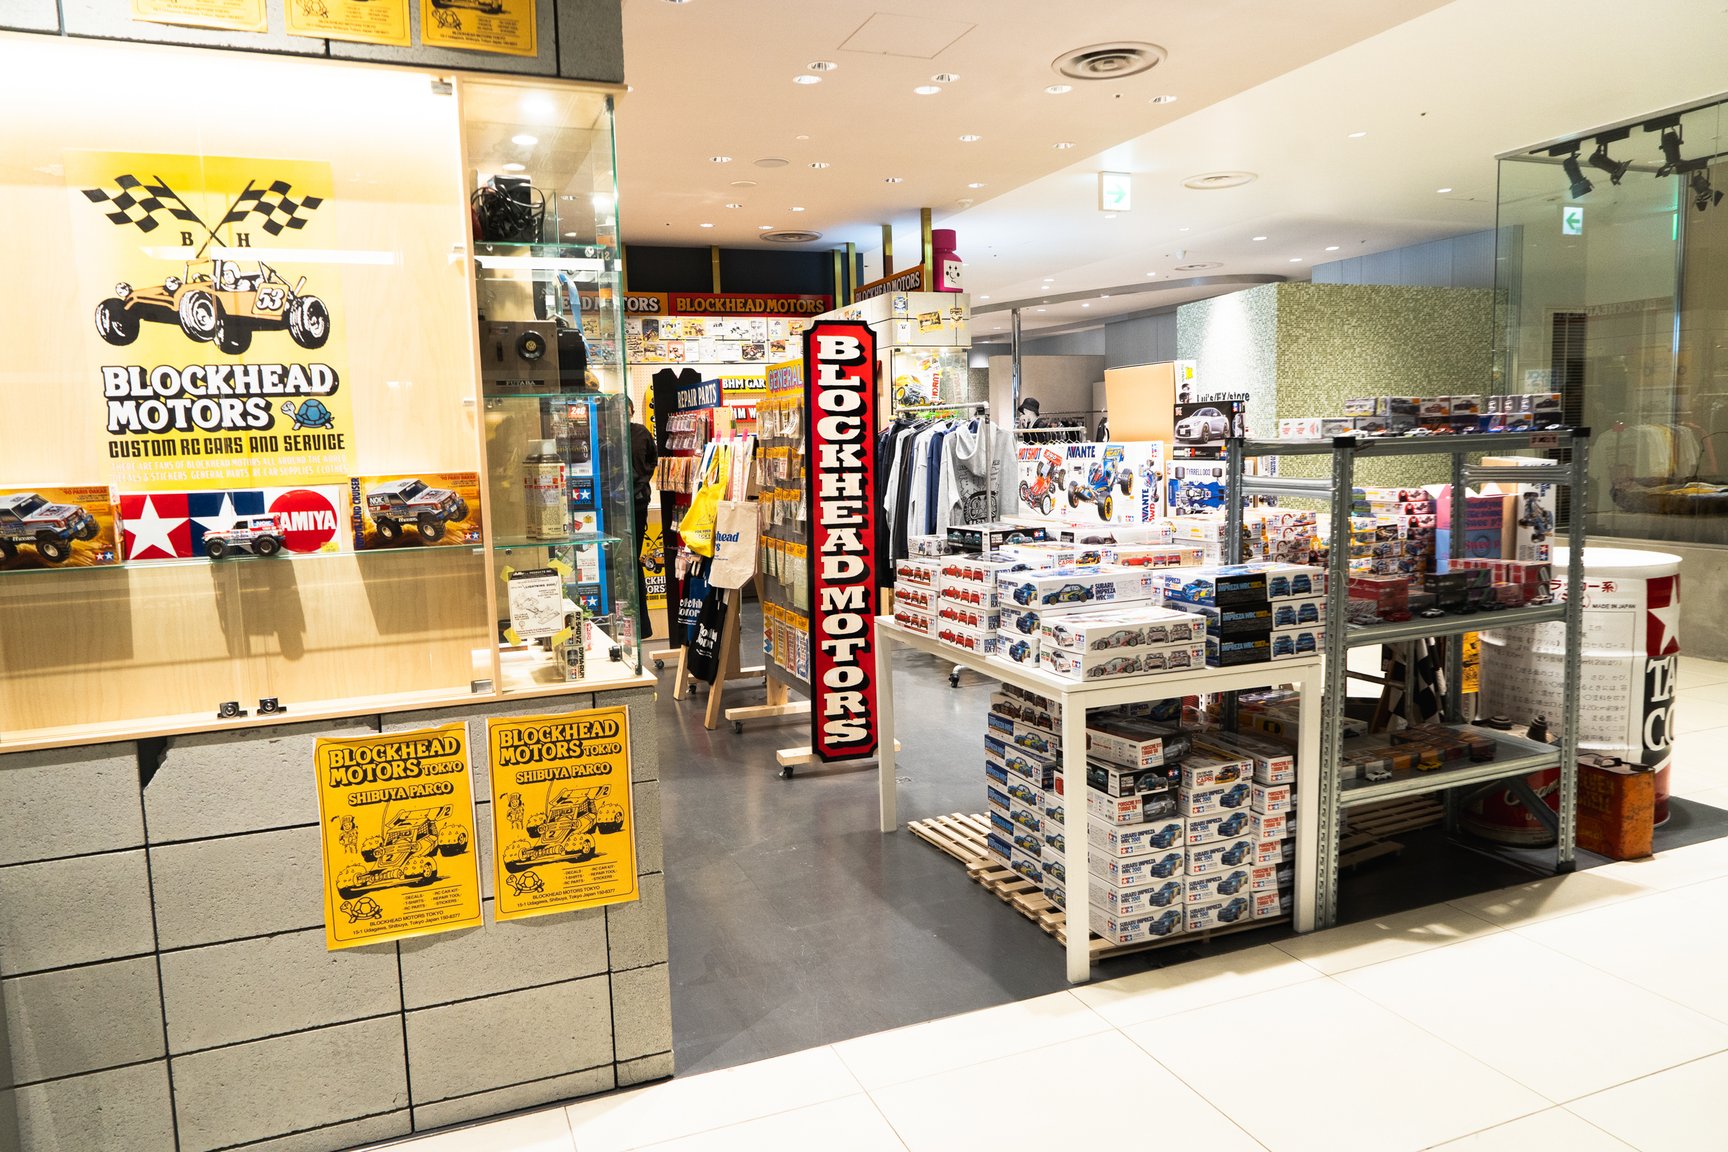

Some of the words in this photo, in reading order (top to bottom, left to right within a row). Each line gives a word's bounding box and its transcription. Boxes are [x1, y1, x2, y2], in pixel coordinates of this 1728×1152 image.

[180, 232, 194, 246] B
[237, 233, 251, 247] H
[892, 271, 921, 292] MOTORS
[256, 288, 285, 311] 53
[677, 297, 765, 314] BLOCKHEAD
[766, 298, 825, 314] MOTORS
[101, 363, 340, 399] BLOCKHEAD
[722, 378, 746, 389] BHM
[768, 363, 803, 394] GENERAL
[677, 389, 698, 409] REPAIR
[698, 383, 717, 406] PARTS
[106, 397, 276, 435] MOTORS
[108, 439, 178, 458] CUSTOM
[180, 437, 201, 456] RC
[204, 436, 244, 455] CARS
[249, 436, 279, 453] AND
[284, 433, 346, 452] SERVICE
[1066, 446, 1096, 460] AVANTE
[186, 457, 231, 469] BLOCKHEAD
[231, 457, 261, 467] MOTORS
[817, 335, 870, 582] BLOCKHEAD
[151, 470, 188, 481] STICKERS
[191, 468, 225, 479] GENERAL
[226, 467, 249, 479] PARTS
[280, 464, 314, 476] SUPPLIES
[351, 477, 361, 505] CRUISER
[1058, 559, 1075, 567] CAPRI
[1095, 587, 1116, 595] IMPREZA
[576, 611, 582, 620] RX
[820, 586, 872, 749] MOTORS
[500, 719, 619, 748] BLOCKHEAD
[328, 737, 461, 769] BLOCKHEAD
[499, 740, 584, 766] MOTORS
[584, 742, 622, 757] TOKYO
[329, 758, 422, 788] MOTORS
[421, 760, 464, 776] TOKYO
[516, 766, 571, 784] SHIBUYA
[571, 762, 612, 777] PARCO
[348, 786, 410, 807] SHIBUYA
[409, 780, 454, 798] PARCO
[1120, 830, 1138, 838] SUBARU
[532, 891, 563, 900] BLOCKHEAD
[1121, 890, 1137, 898] SUBARU
[369, 917, 403, 927] BLOCKHEAD
[402, 913, 426, 922] MOTORS
[425, 910, 444, 918] TOKYO
[410, 919, 424, 927] Tokyo
[425, 916, 440, 925] Japan
[1120, 919, 1137, 927] SUBARU
[1136, 916, 1154, 924] IMPREZA
